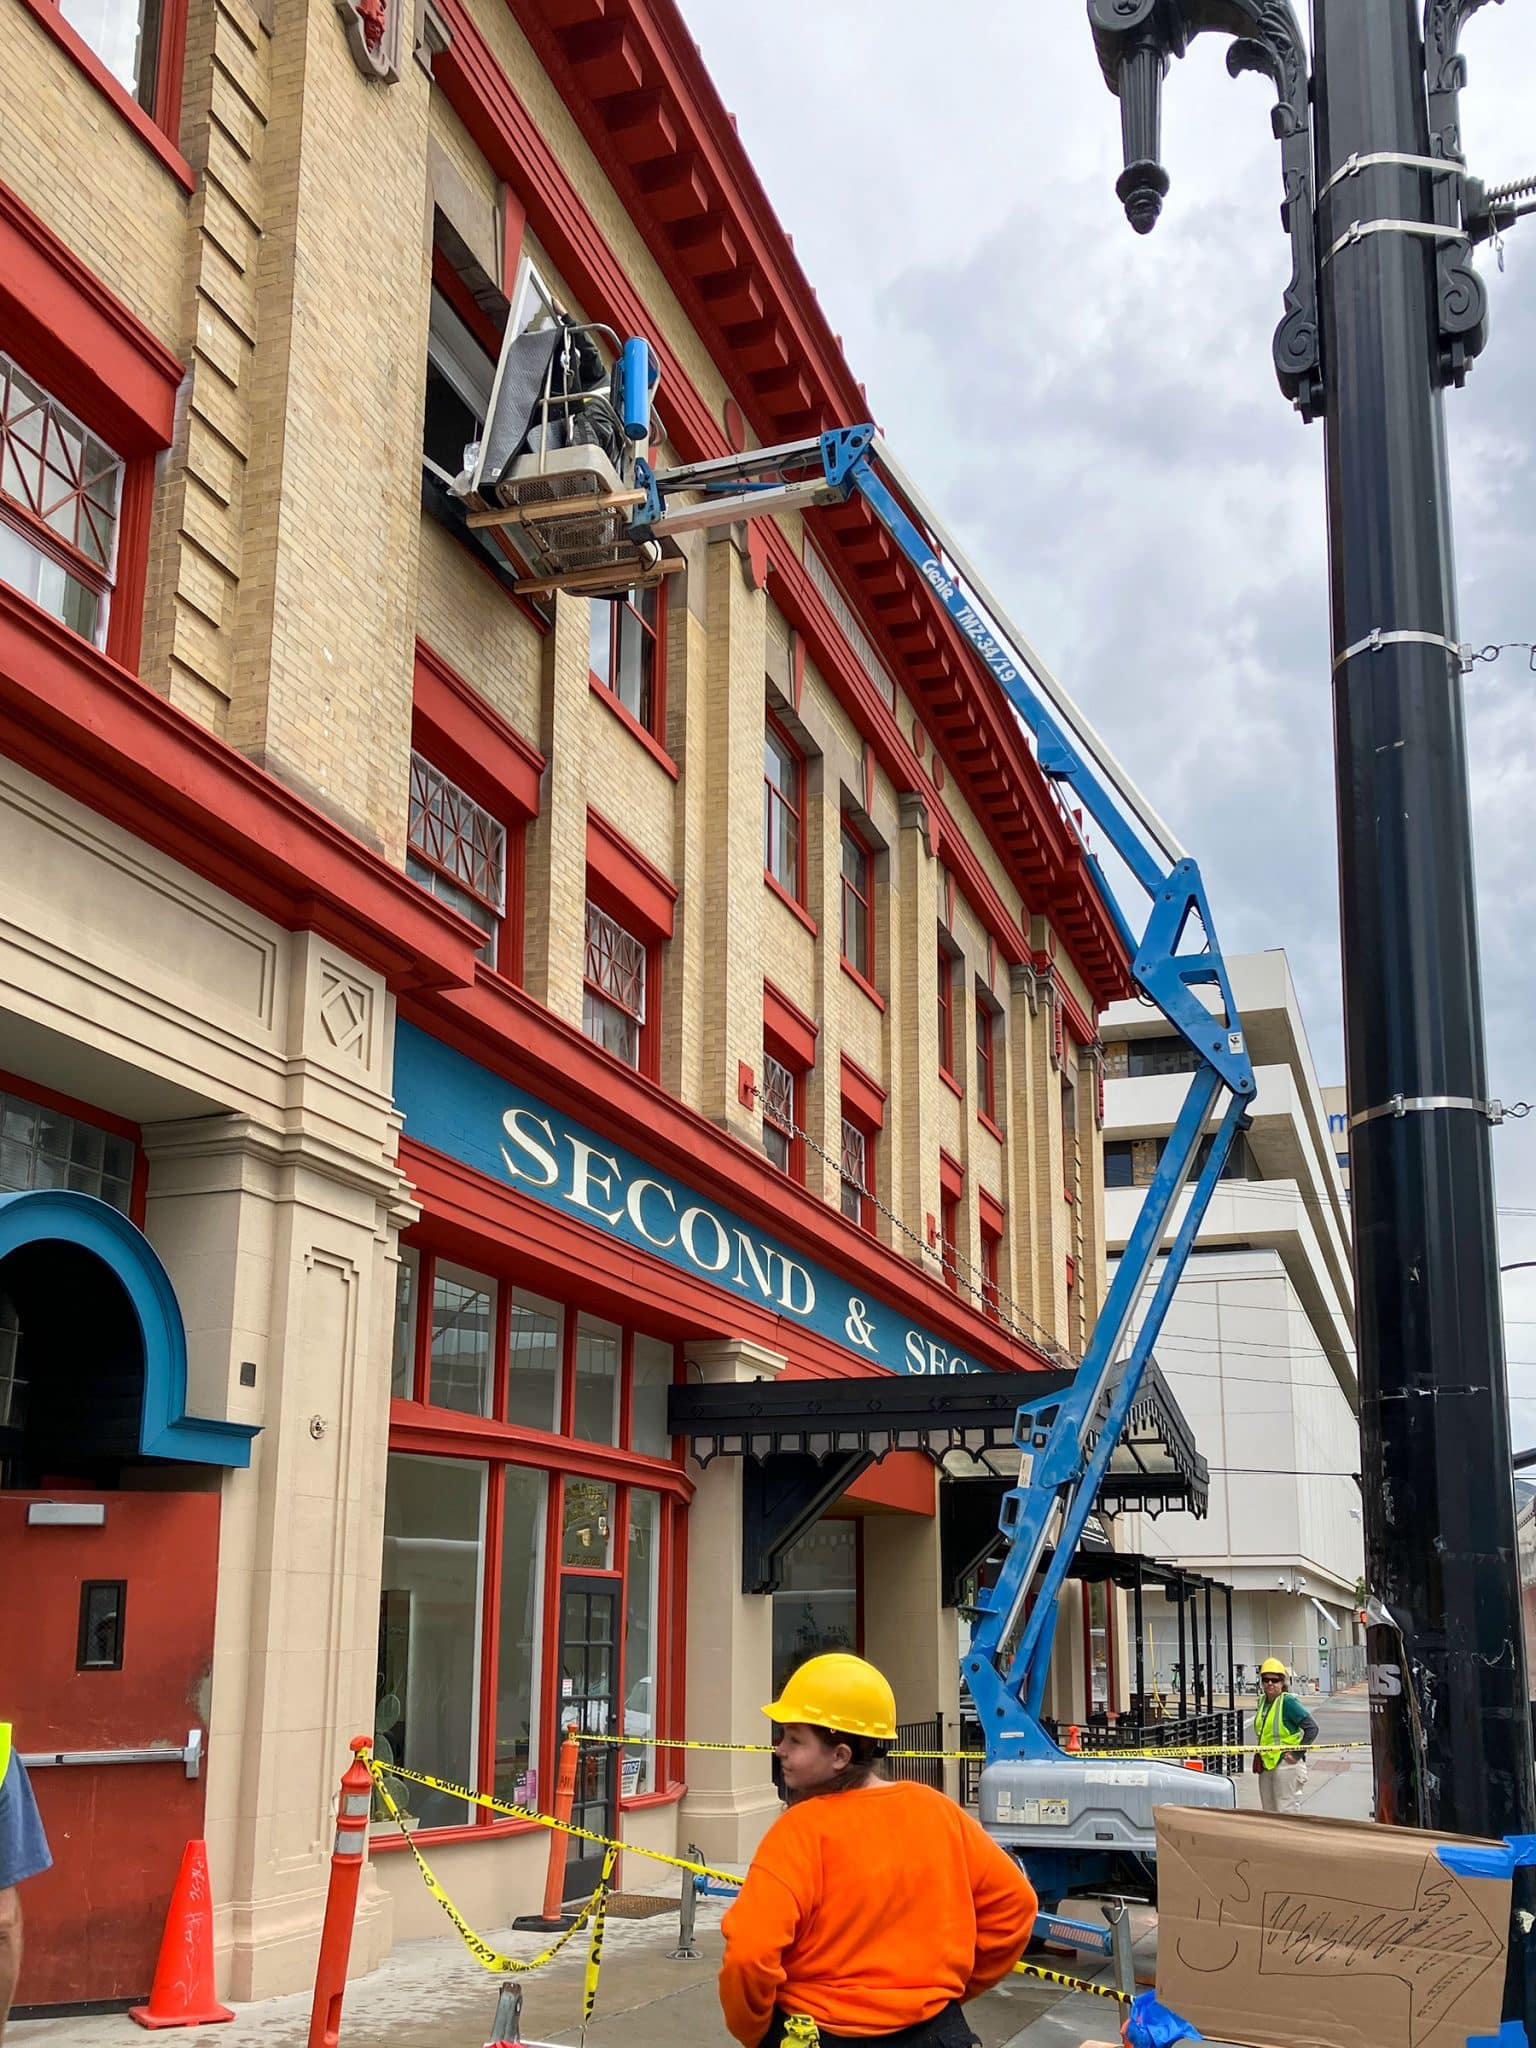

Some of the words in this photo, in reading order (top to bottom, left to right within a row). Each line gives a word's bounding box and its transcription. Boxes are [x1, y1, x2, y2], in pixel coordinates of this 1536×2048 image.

[921, 558, 954, 601] Genie
[500, 1107, 816, 1316] SECOND
[845, 1296, 880, 1353] &
[905, 1331, 982, 1375] SEC
[1106, 1749, 1145, 1758] CAUTION
